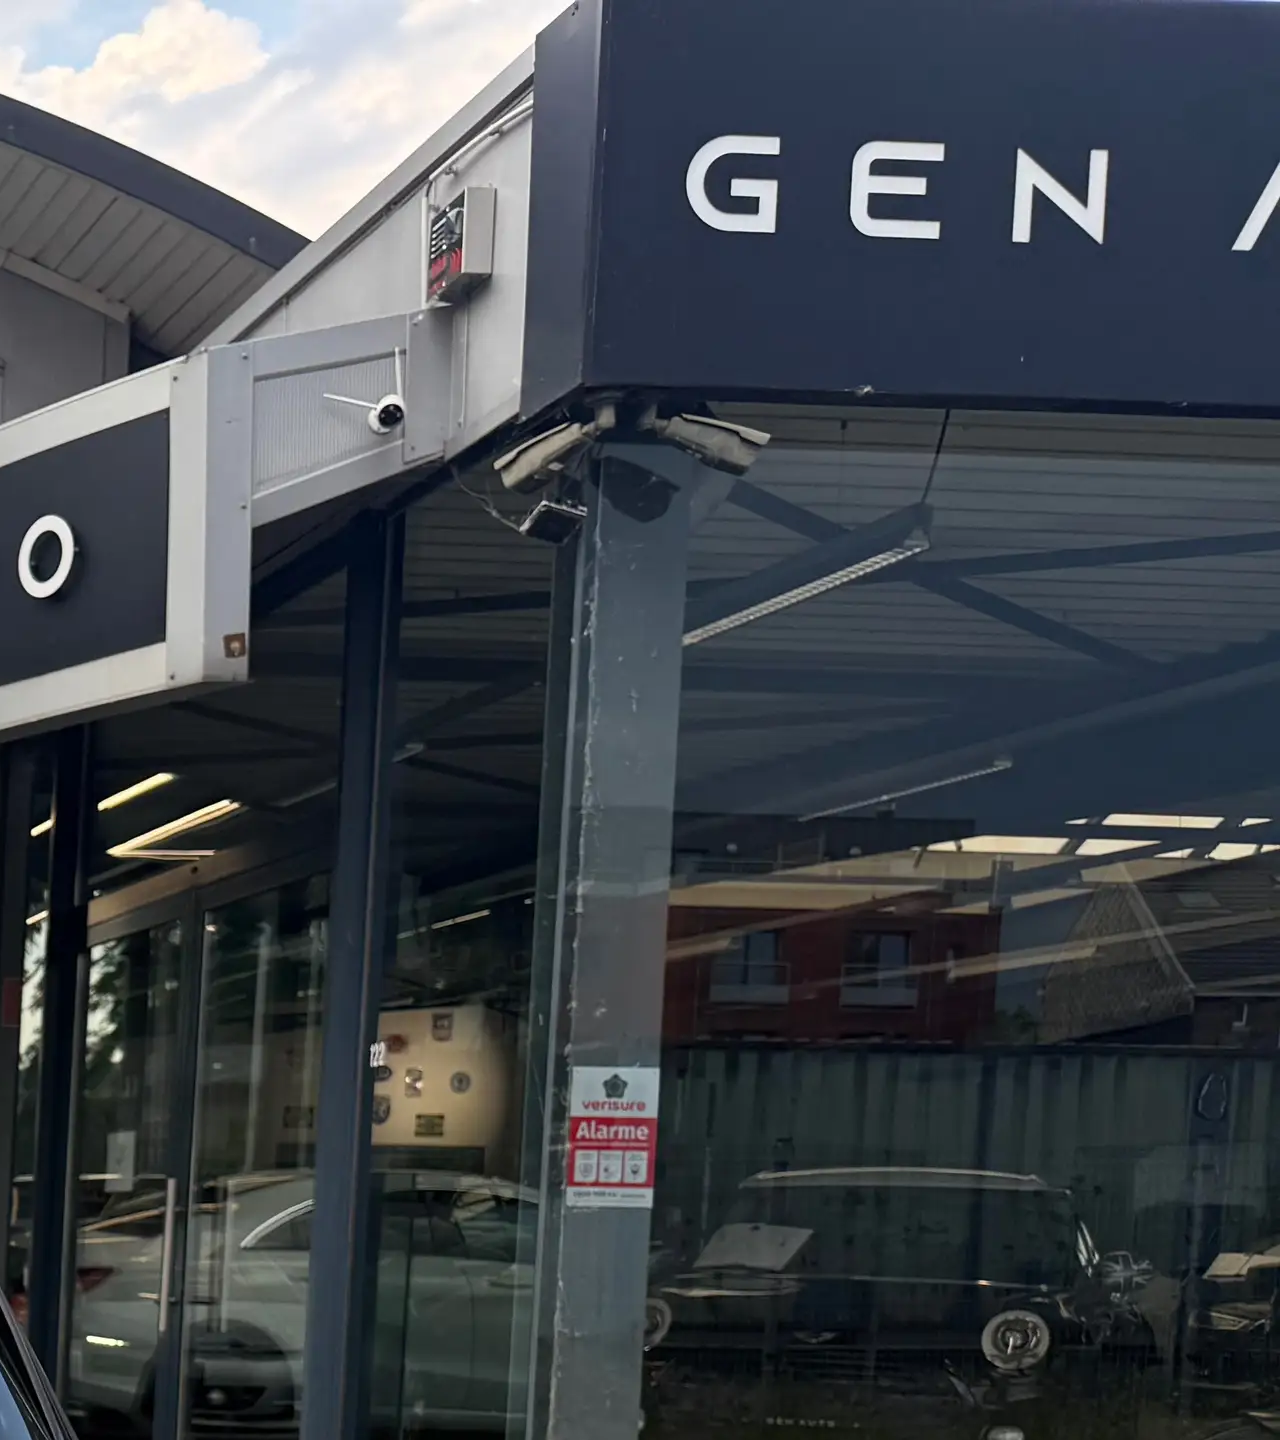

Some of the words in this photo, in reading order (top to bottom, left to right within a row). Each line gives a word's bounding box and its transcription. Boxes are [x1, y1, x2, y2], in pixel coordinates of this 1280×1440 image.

[685, 134, 1109, 245] GEN
[582, 1099, 647, 1112] verisure
[576, 1120, 649, 1141] Alarme
